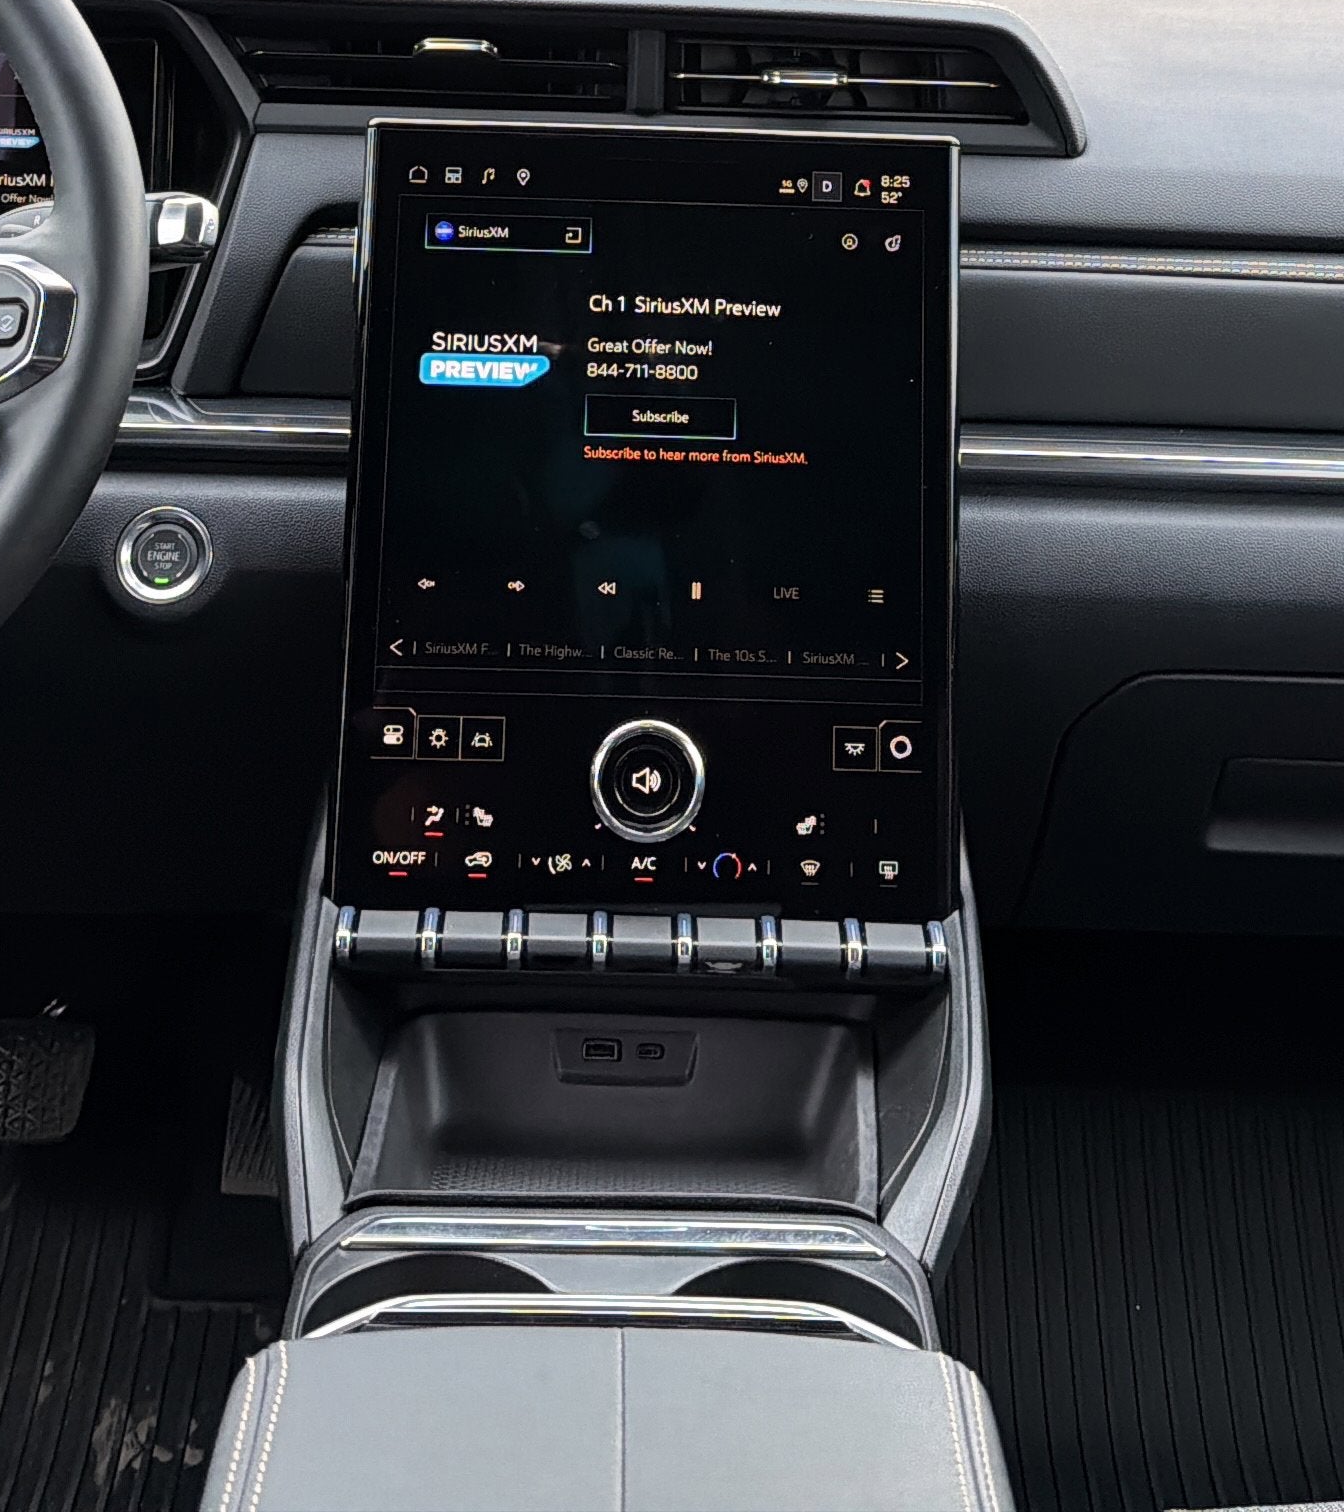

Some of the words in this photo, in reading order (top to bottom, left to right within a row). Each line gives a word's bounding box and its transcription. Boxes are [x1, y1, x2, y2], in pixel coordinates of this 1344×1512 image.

[822, 180, 833, 192] D
[880, 175, 911, 188] 8:25
[0, 193, 27, 204] Offer
[33, 214, 41, 226] R
[457, 225, 510, 239] SiriusXM
[588, 294, 613, 313] Ch
[616, 296, 626, 313] 1
[634, 296, 710, 316] SiriusXM
[714, 299, 782, 317] Preview
[431, 331, 538, 354] SIRIUSXM
[587, 338, 629, 355] Great
[631, 339, 671, 356] Offer
[675, 341, 713, 356] Now!
[429, 359, 540, 381] PREVIEW
[586, 362, 699, 381] 844-711-8800
[631, 408, 690, 425] Subscribe
[583, 445, 642, 461] Subscribe
[643, 447, 657, 461] to
[658, 447, 687, 462] hear
[688, 451, 720, 462] more
[722, 449, 752, 463] from
[753, 451, 809, 465] SiriusXM.
[147, 551, 181, 562] ENGINE
[772, 587, 800, 601] LIVE
[424, 640, 478, 656] SiriusXM
[518, 643, 541, 658] The
[614, 645, 655, 661] Classic
[707, 648, 731, 663] The
[734, 649, 756, 663] 10s
[802, 651, 856, 666] SiriusXM
[372, 850, 427, 865] ON/OFF
[630, 855, 657, 872] A/C
